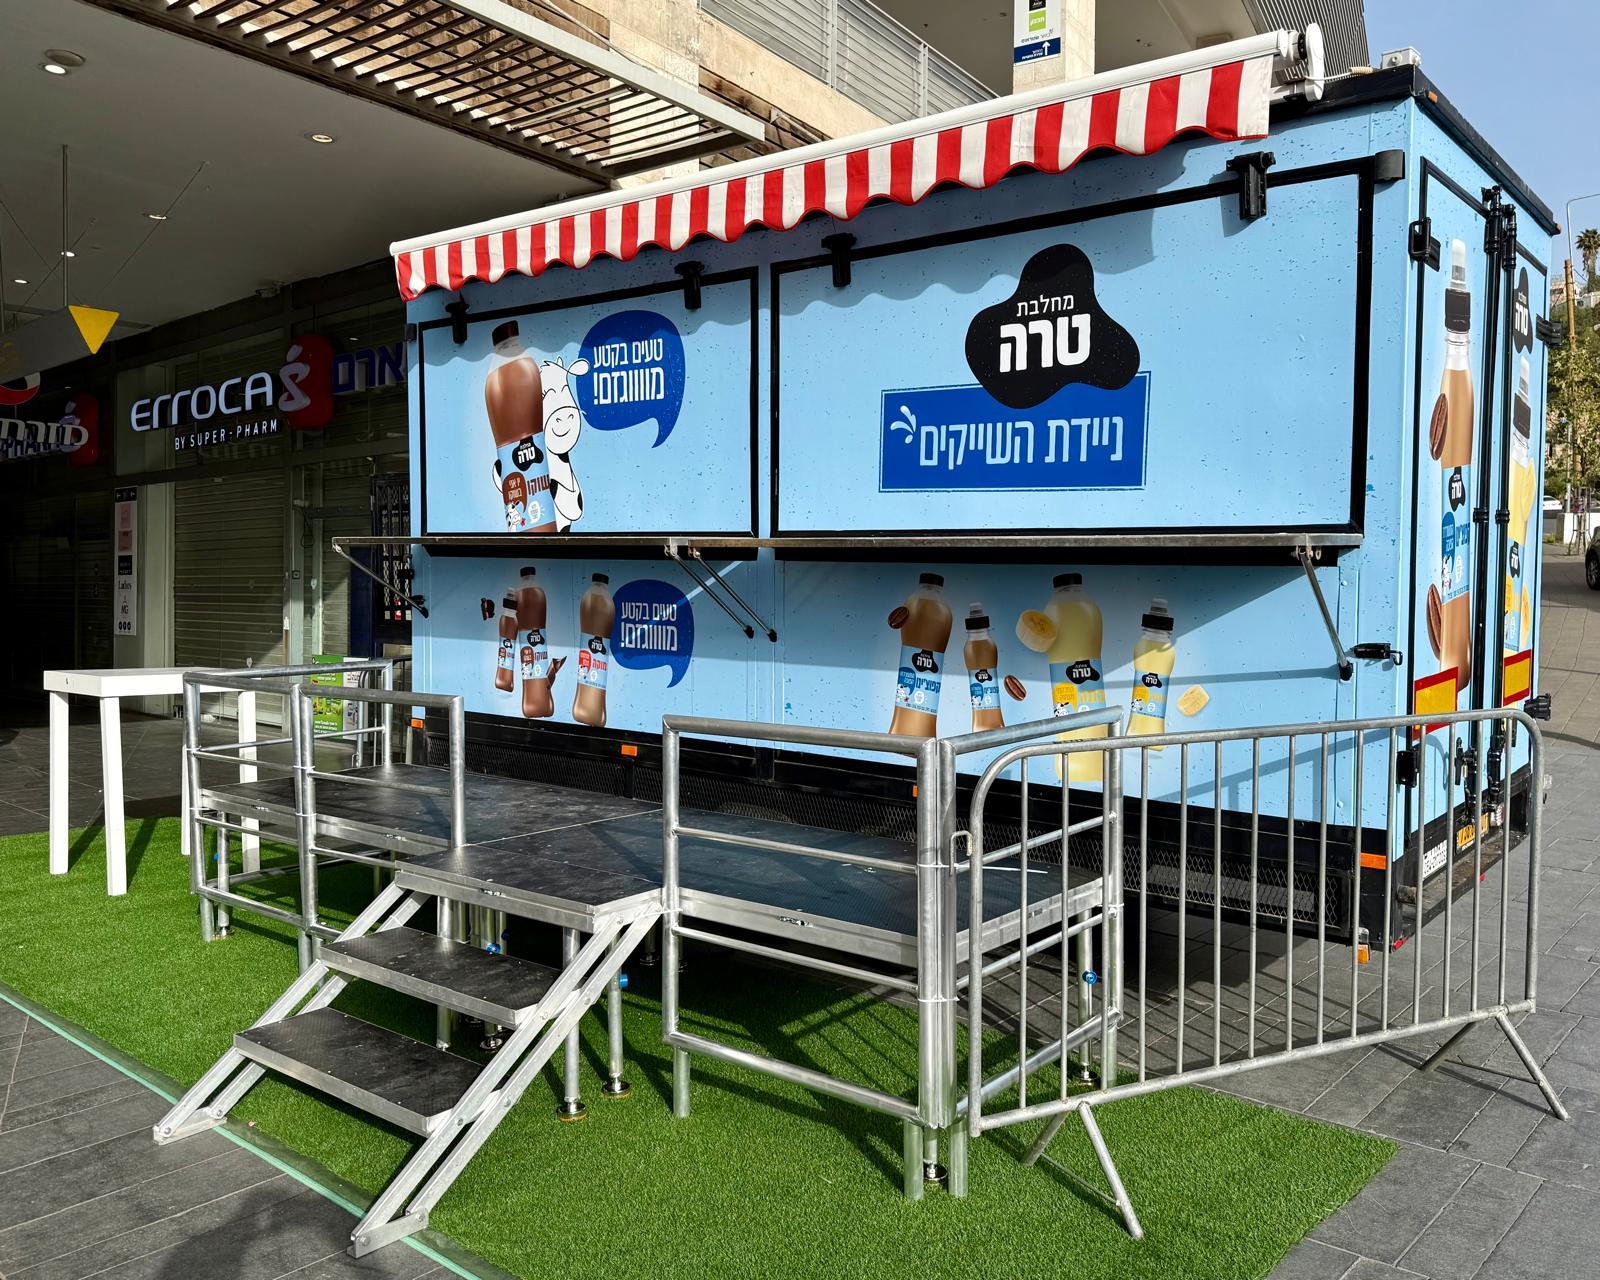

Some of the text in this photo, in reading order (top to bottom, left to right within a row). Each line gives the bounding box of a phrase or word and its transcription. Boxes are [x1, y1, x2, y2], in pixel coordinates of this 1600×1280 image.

[1016, 294, 1074, 317] מחלבת
[593, 338, 663, 369] טעים בקטע
[1000, 313, 1091, 373] טרה
[593, 367, 665, 405] מווווגזם!
[174, 418, 278, 450] BY SUPER-PHARM
[919, 416, 1124, 470] ניידת השייקים
[518, 446, 536, 464] טרה
[527, 474, 550, 496] שוקו
[621, 602, 677, 622] טעים בקטע
[916, 656, 933, 668] טרה
[1072, 667, 1092, 679] טרה
